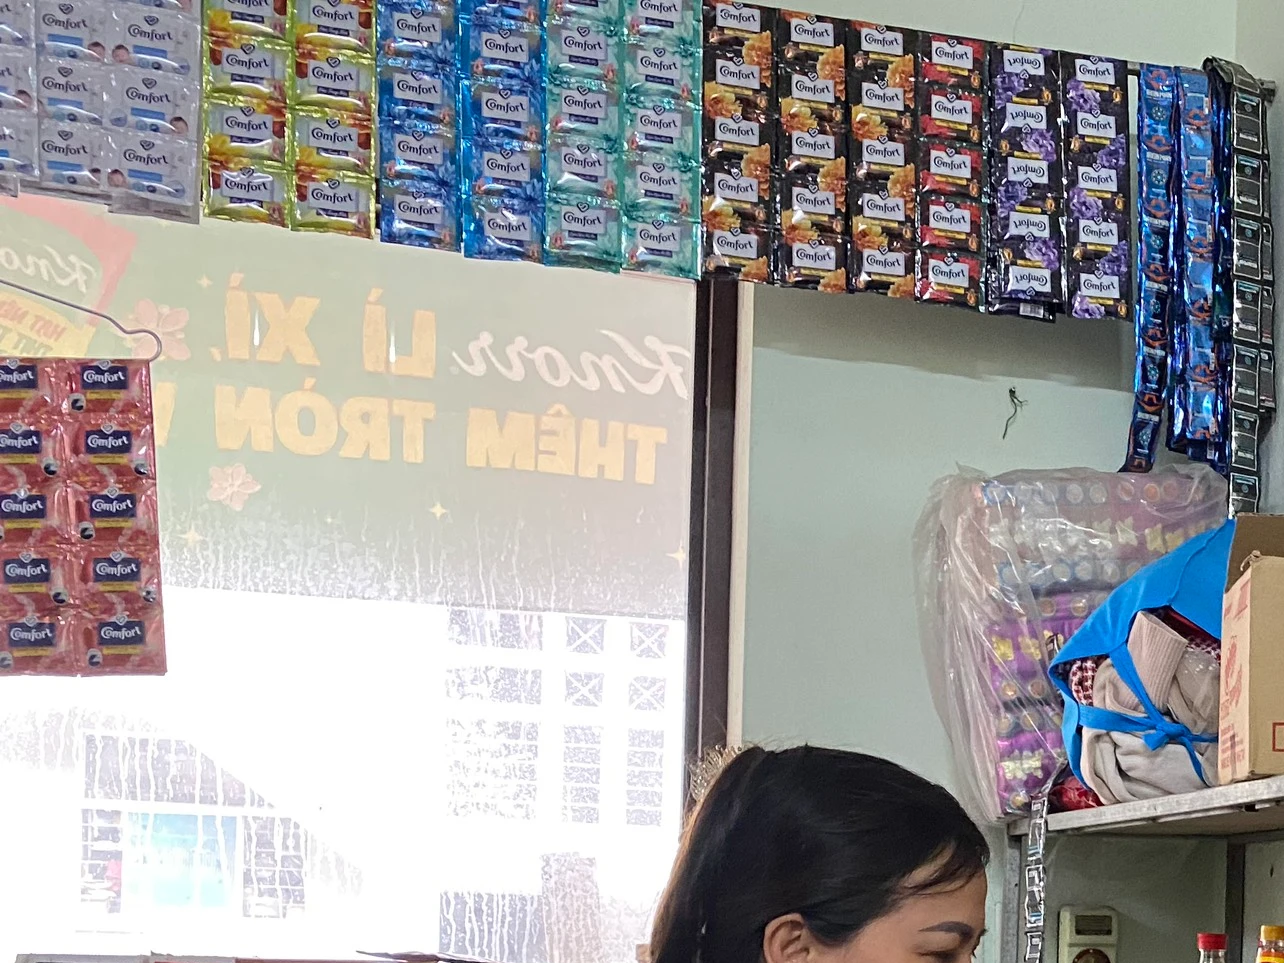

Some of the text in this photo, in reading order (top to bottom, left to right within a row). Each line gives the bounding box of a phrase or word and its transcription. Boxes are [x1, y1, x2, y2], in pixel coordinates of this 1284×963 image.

[312, 6, 355, 22] Comfort
[641, 0, 678, 13] Comfort
[42, 13, 88, 30] Comfort
[720, 9, 757, 24] Comfort
[128, 22, 173, 41] Comfort
[397, 19, 437, 34] Comfort
[485, 38, 525, 54] Comfort
[562, 37, 602, 52] Comfort
[864, 33, 900, 48] Comfort
[226, 53, 269, 69] Comfort
[640, 58, 678, 73] Comfort
[312, 67, 354, 83] Comfort
[720, 66, 757, 82] Comfort
[1078, 64, 1111, 78] Comfort
[42, 76, 88, 93] Comfort
[397, 79, 438, 95] Comfort
[125, 86, 170, 104] Comfort
[564, 95, 602, 110] Comfort
[865, 89, 901, 104] Comfort
[485, 98, 525, 114] Comfort
[934, 102, 968, 117] Comfort
[226, 115, 268, 131] Comfort
[640, 116, 678, 130] Comfort
[1080, 117, 1112, 131] Comfort
[311, 127, 353, 143] Comfort
[41, 140, 88, 156] Comfort
[398, 141, 439, 156] Comfort
[866, 145, 902, 160] Comfort
[123, 148, 168, 165] Comfort
[563, 154, 602, 170] Comfort
[486, 157, 526, 173] Comfort
[224, 177, 268, 193] Comfort
[639, 172, 677, 186] Comfort
[1081, 172, 1114, 185] Comfort
[718, 180, 756, 196] Comfort
[311, 188, 353, 204] Comfort
[398, 200, 439, 217] Comfort
[866, 200, 902, 216] Comfort
[487, 217, 527, 233] Comfort
[563, 213, 602, 228] Comfort
[639, 231, 677, 244] Comfort
[1082, 226, 1115, 240] Comfort
[716, 236, 754, 252] Comfort
[866, 256, 902, 270] Comfort
[1083, 279, 1116, 292] Comfort
[83, 370, 125, 384] Comfort
[0, 435, 39, 447] Comfort
[87, 435, 129, 448] Comfort
[1, 499, 43, 512] Comfort
[91, 498, 133, 512] Comfort
[5, 563, 48, 576] Comfort
[96, 563, 138, 576] Comfort
[11, 626, 52, 641] Comfort
[100, 626, 141, 640] Comfort
